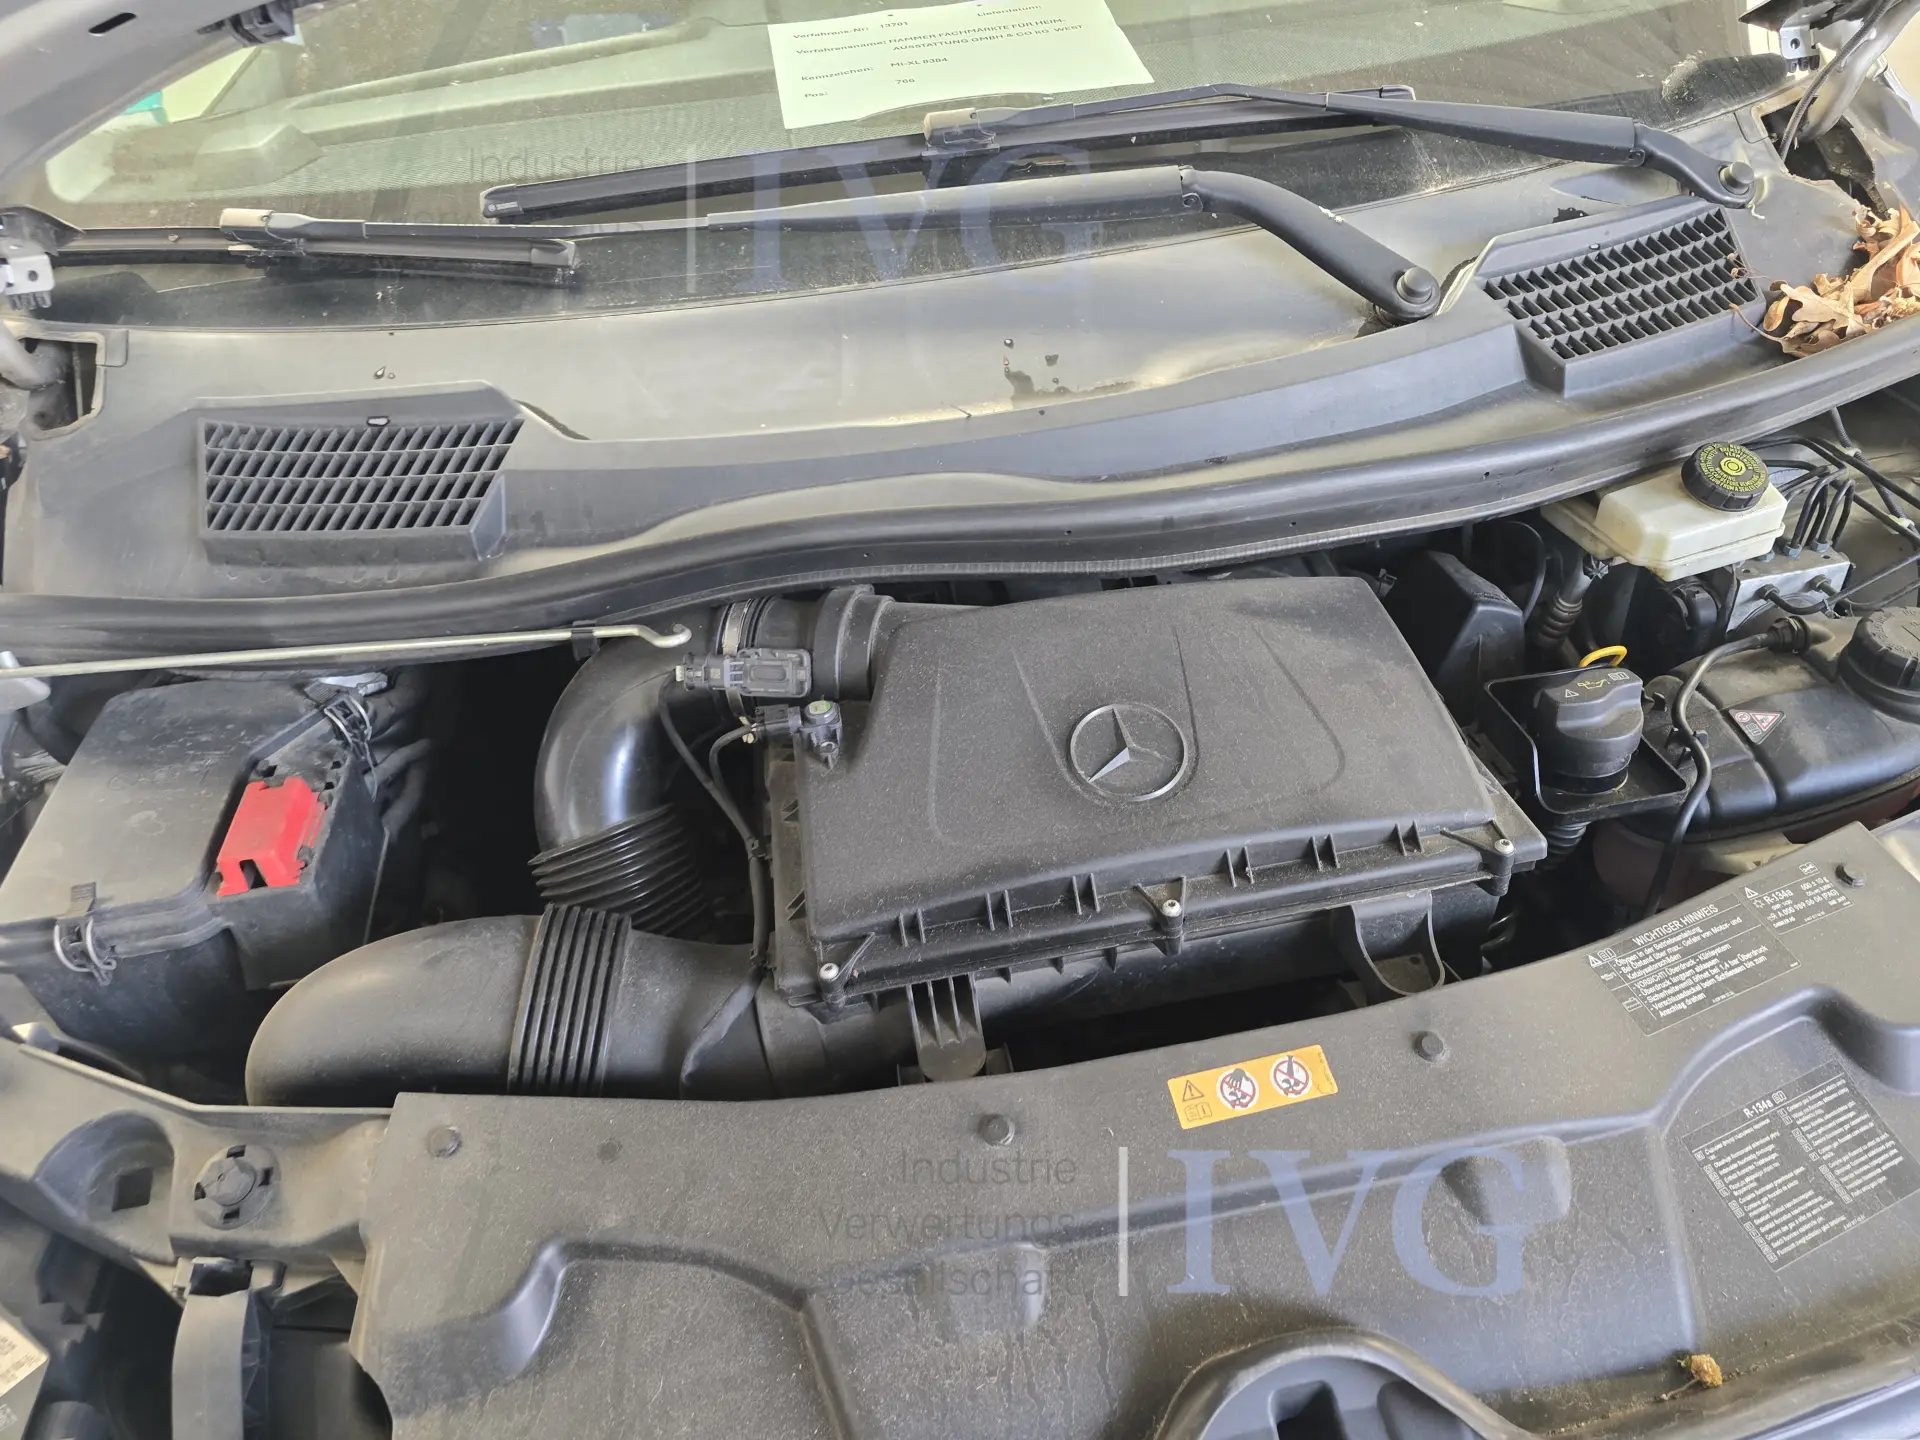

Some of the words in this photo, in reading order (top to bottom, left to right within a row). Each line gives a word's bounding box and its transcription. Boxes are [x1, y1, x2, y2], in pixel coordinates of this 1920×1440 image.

[889, 34, 937, 44] HAMMER
[893, 37, 970, 51] AUSSTATTUNG
[971, 33, 1004, 43] GMBH
[1053, 24, 1084, 33] WEST
[801, 67, 875, 81] Kennzeichen:
[890, 59, 921, 68] MI-XL
[1763, 890, 1793, 904] R-134a
[1632, 920, 1684, 946] WICHTIGER
[1680, 904, 1719, 925] HINWEIS
[1653, 951, 1666, 959] über
[1682, 936, 1701, 946] Gefahr
[1711, 923, 1730, 933] Motor-
[1730, 917, 1742, 925] und
[1670, 969, 1695, 982] langsam
[1744, 1100, 1773, 1118] R-134a
